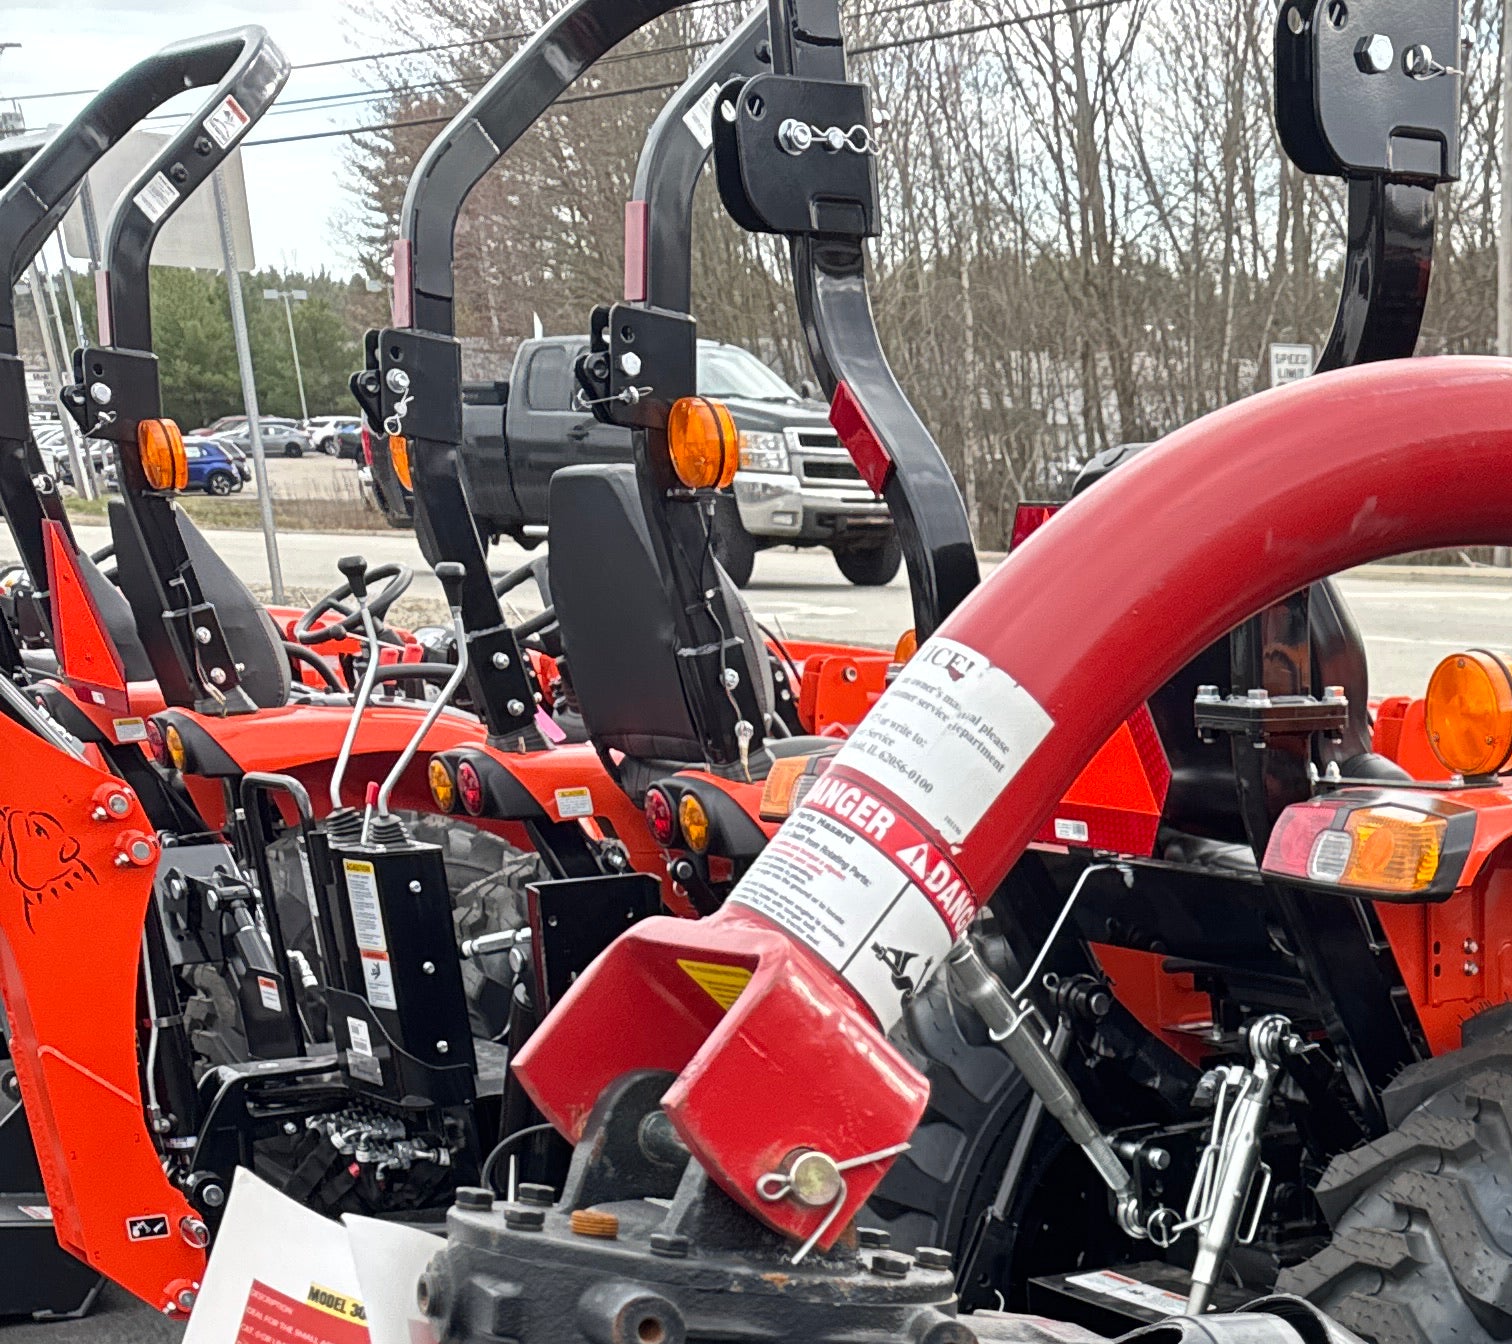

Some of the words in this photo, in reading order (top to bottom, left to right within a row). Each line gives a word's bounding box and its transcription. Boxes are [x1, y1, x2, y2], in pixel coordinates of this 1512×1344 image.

[1276, 353, 1307, 364] SPEED
[948, 722, 1005, 773] department
[979, 723, 1010, 754] please
[817, 817, 855, 844] Hazard
[308, 1286, 346, 1314] MODEL
[295, 1329, 318, 1344] SMALL
